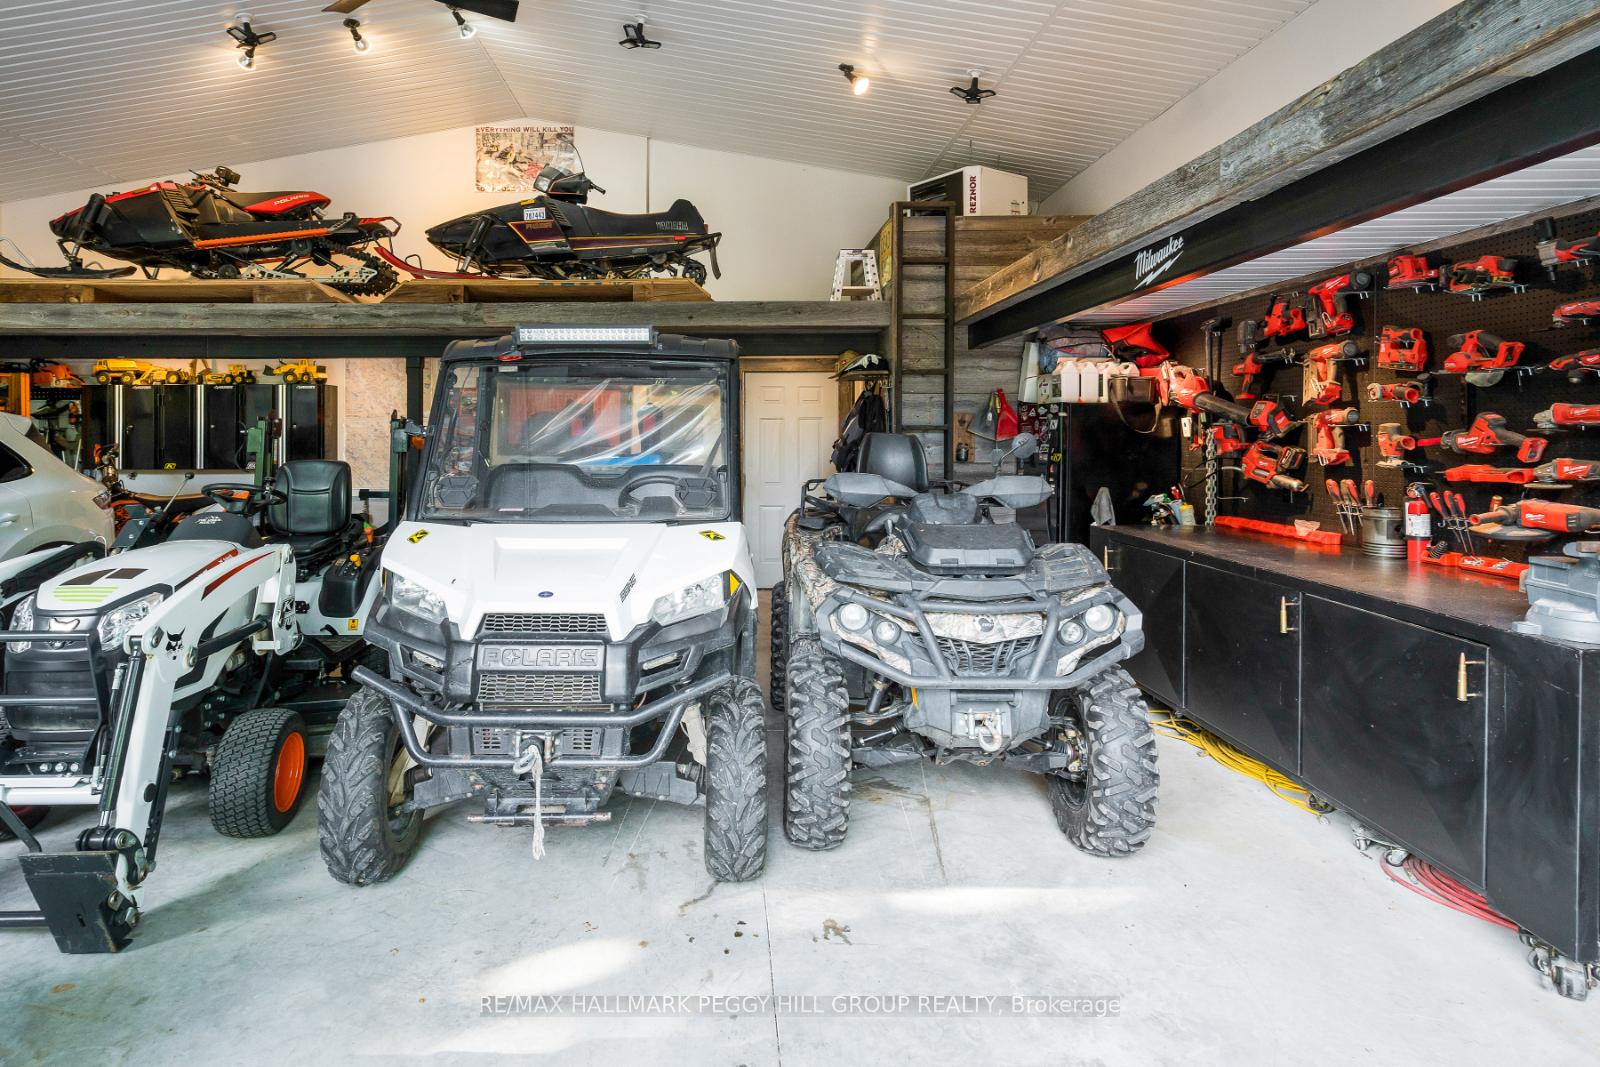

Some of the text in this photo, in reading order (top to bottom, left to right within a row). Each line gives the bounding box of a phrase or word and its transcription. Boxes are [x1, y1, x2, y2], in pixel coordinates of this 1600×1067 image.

[969, 175, 977, 214] REZNOR
[1134, 236, 1184, 280] Milwaukee
[482, 648, 599, 667] POLARIS
